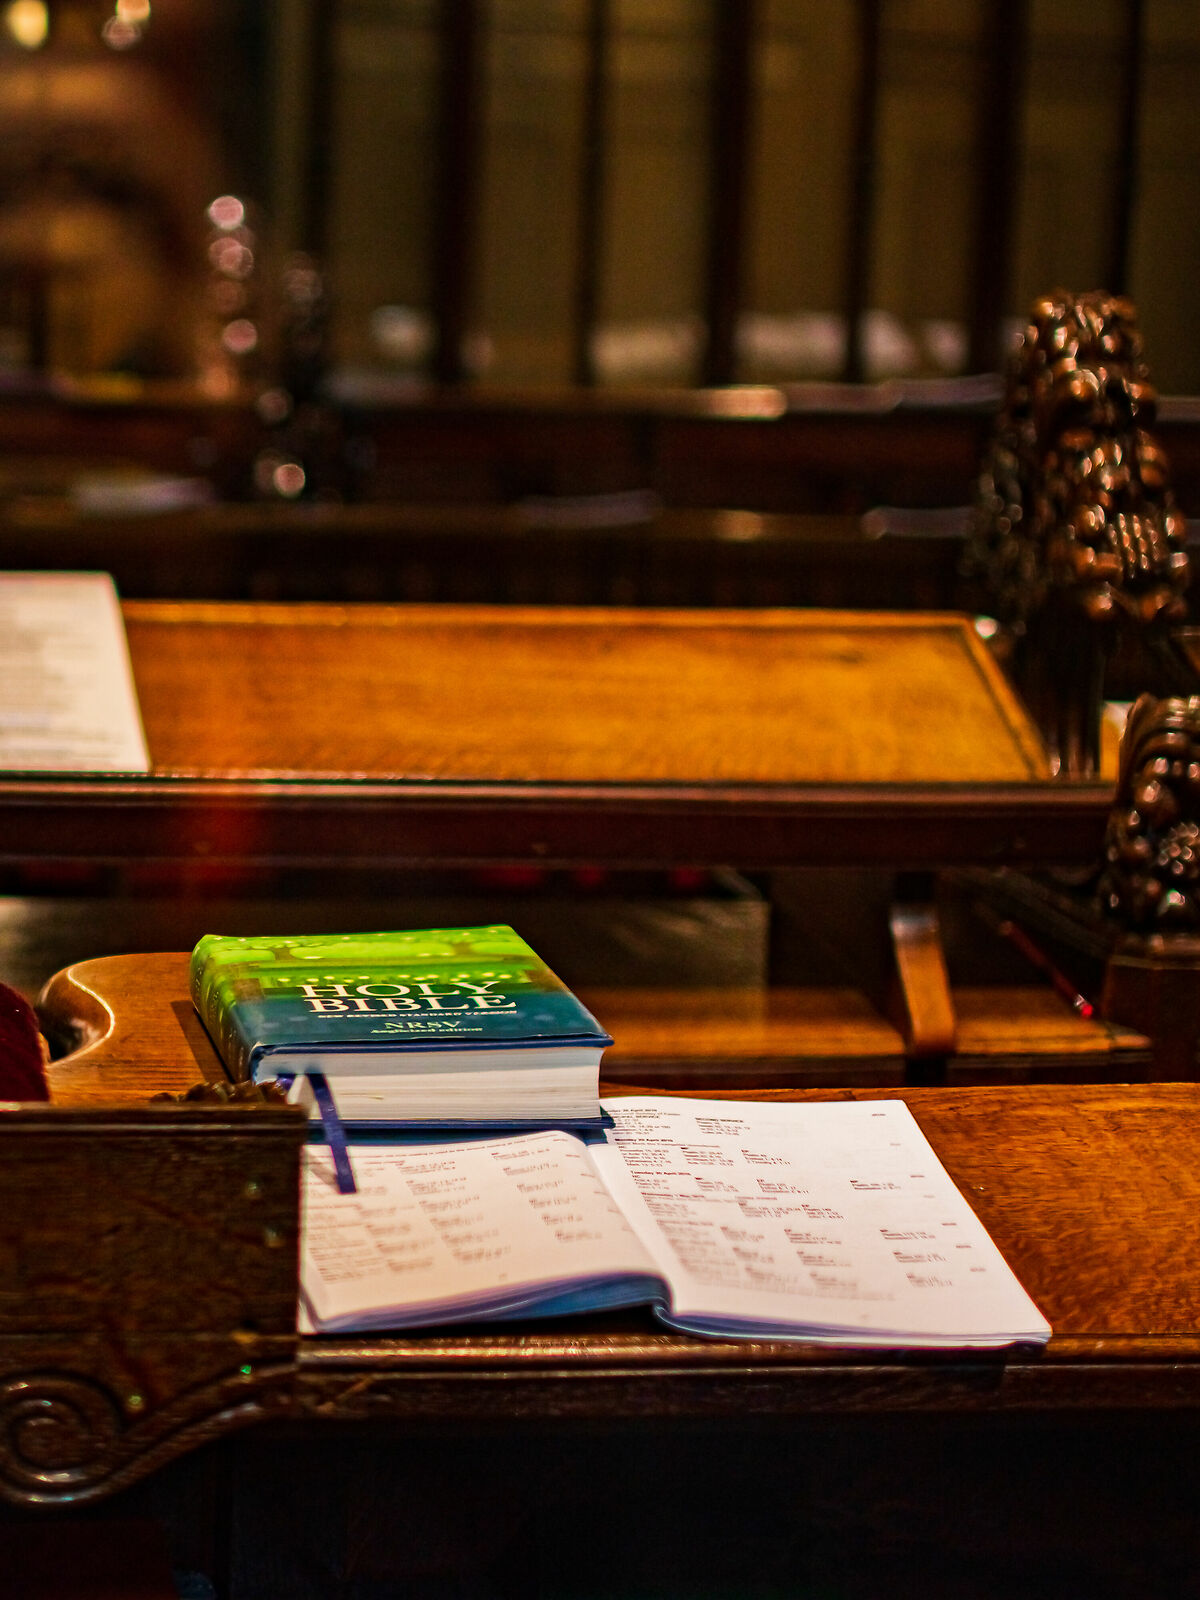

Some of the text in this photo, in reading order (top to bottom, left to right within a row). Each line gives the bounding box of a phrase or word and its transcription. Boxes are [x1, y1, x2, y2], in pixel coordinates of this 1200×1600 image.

[297, 982, 500, 997] HOLY
[304, 995, 517, 1012] BIBLE
[383, 1020, 461, 1029] NRSV
